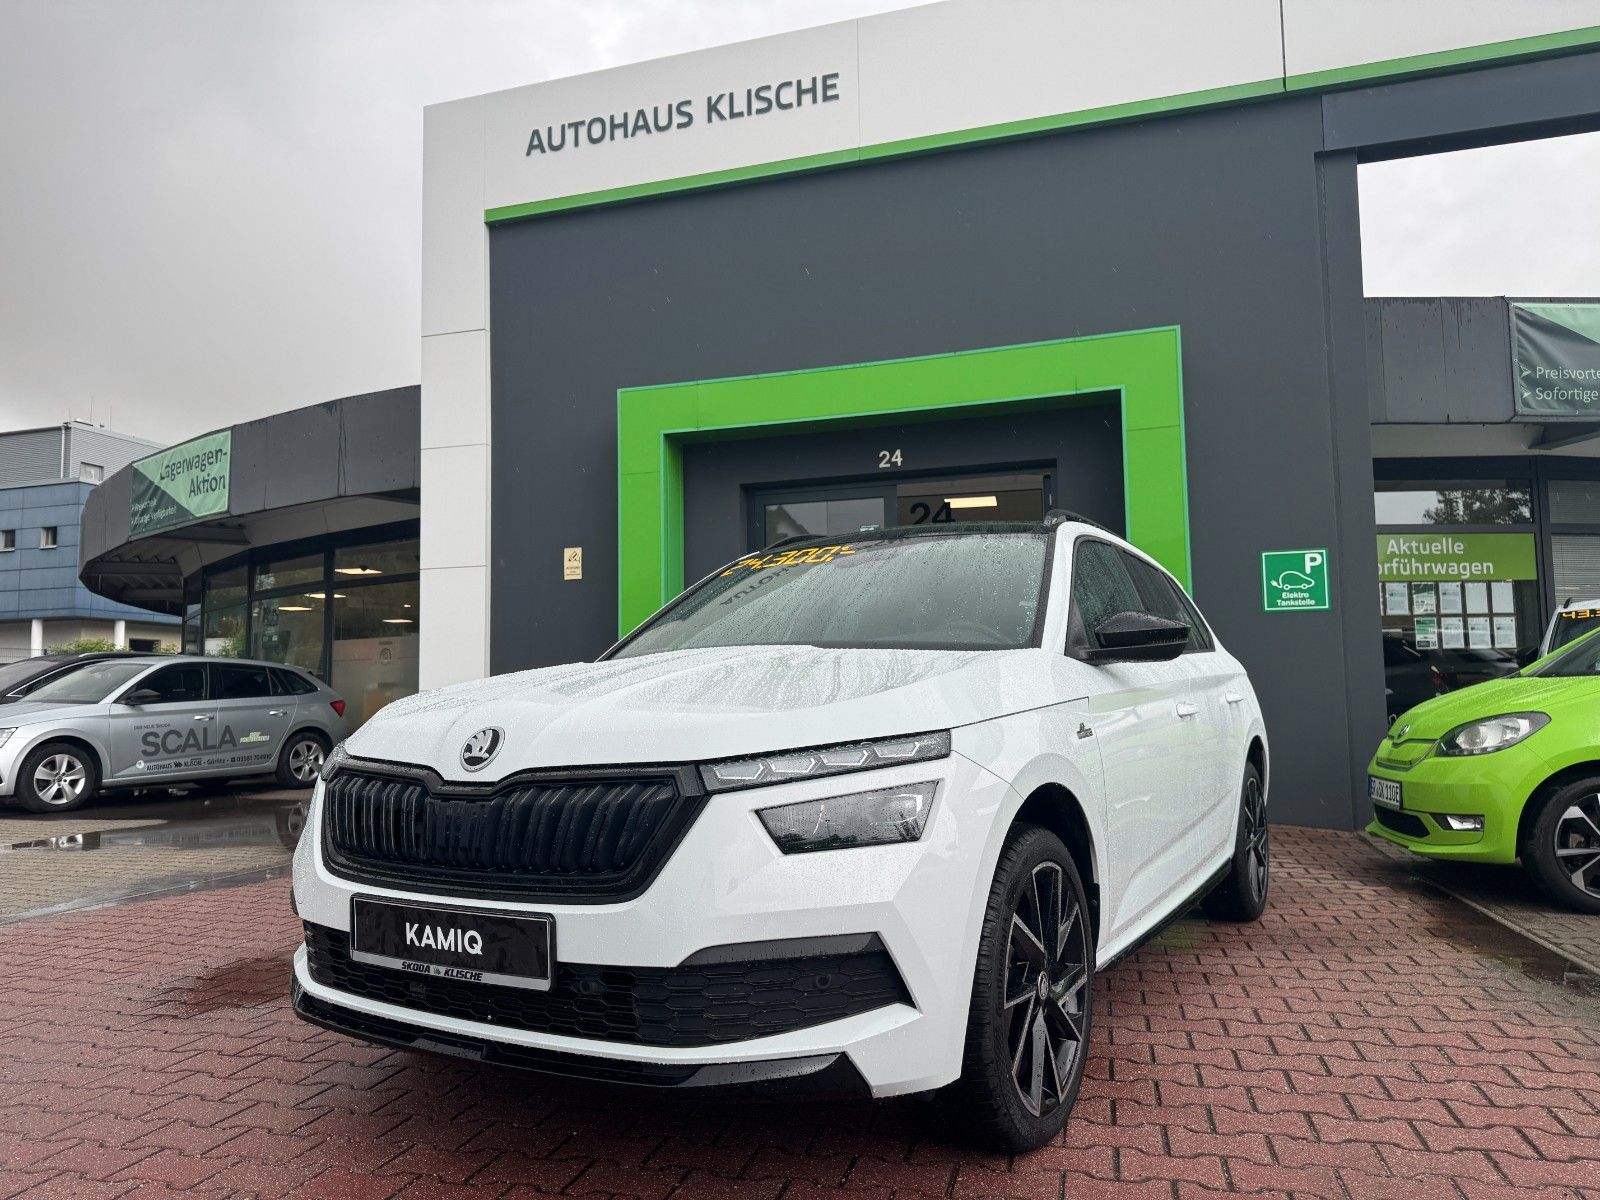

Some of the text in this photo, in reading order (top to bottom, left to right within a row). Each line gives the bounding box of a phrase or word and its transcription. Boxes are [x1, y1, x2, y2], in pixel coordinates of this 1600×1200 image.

[525, 72, 840, 157] AUTOHAUS KLISCHE
[1535, 386, 1599, 403] Sofortige
[160, 447, 228, 481] Lagerwagen-
[878, 448, 903, 468] 24
[188, 473, 226, 498] Aktion
[909, 502, 956, 525] 24
[1386, 537, 1465, 555] Aktuelle
[1304, 553, 1322, 574] P
[1276, 599, 1316, 607] Tankstelle
[141, 725, 238, 757] SCALA
[405, 922, 483, 955] KAMIQ
[401, 960, 483, 981] SKODA KLISCHE
